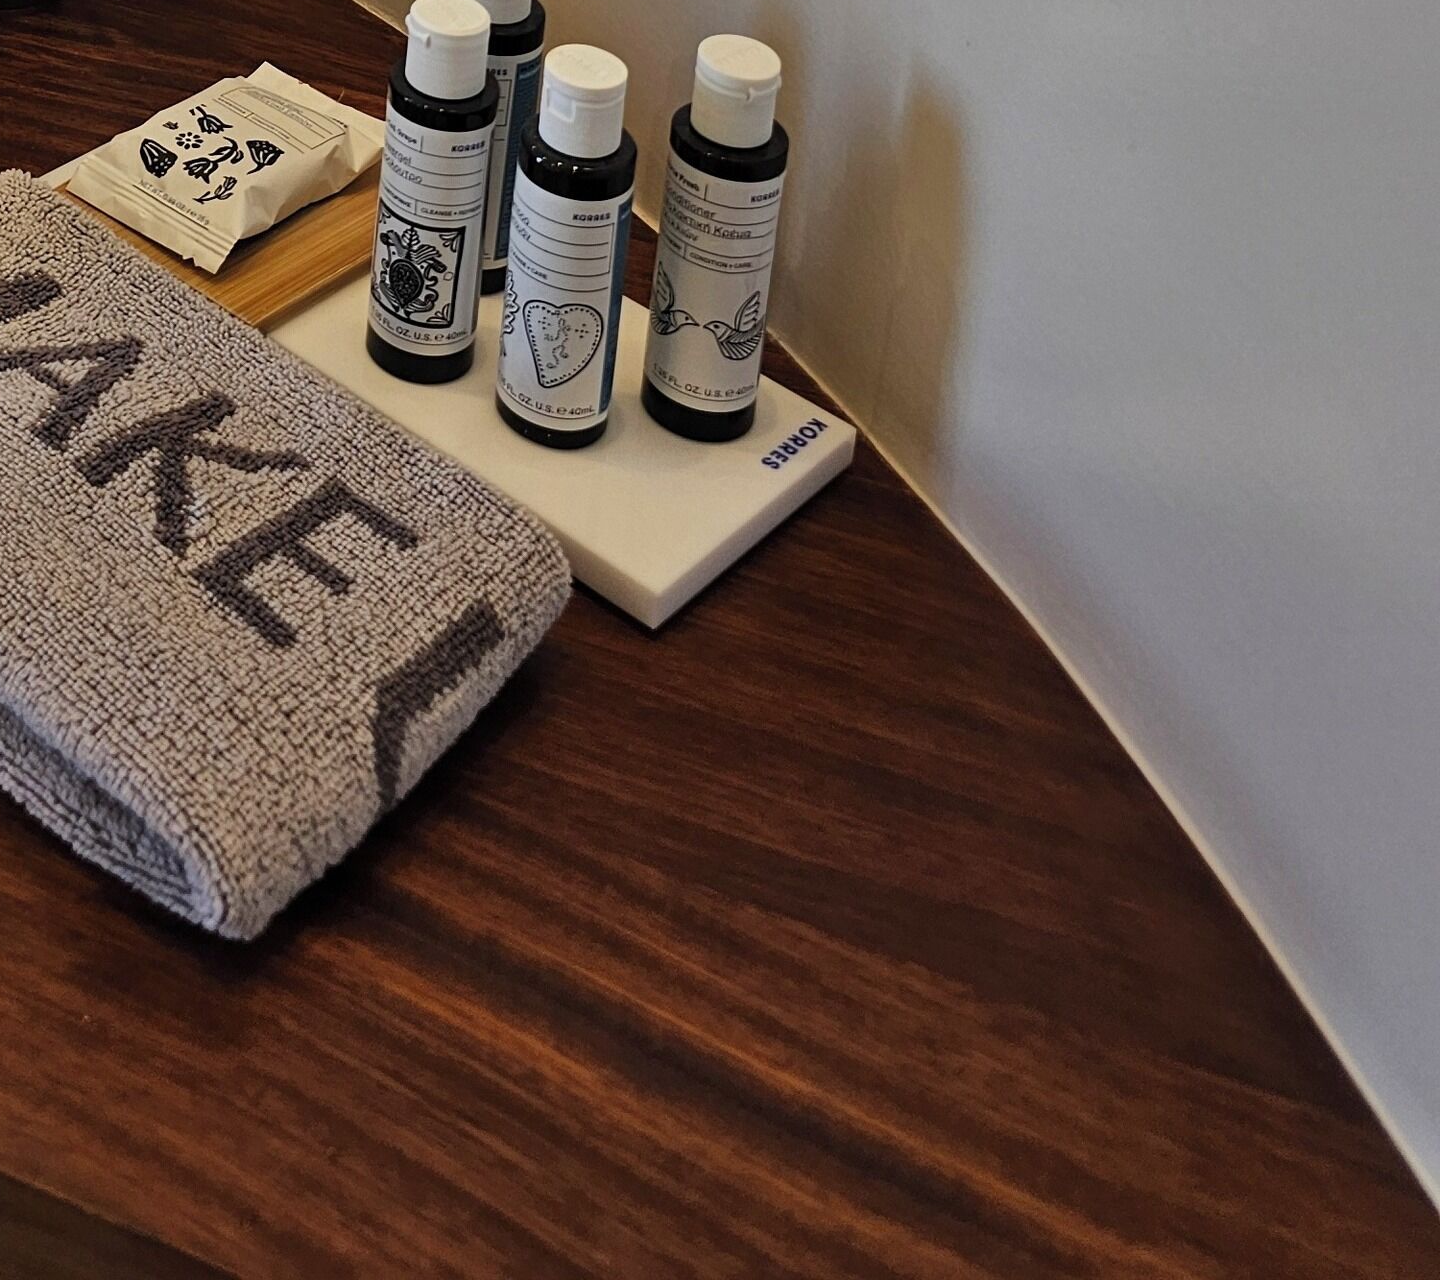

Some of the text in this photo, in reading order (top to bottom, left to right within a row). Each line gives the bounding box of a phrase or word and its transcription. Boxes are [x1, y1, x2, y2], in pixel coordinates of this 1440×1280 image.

[450, 140, 486, 153] KORRES
[572, 212, 612, 223] KORRES
[760, 417, 829, 470] KORRES
